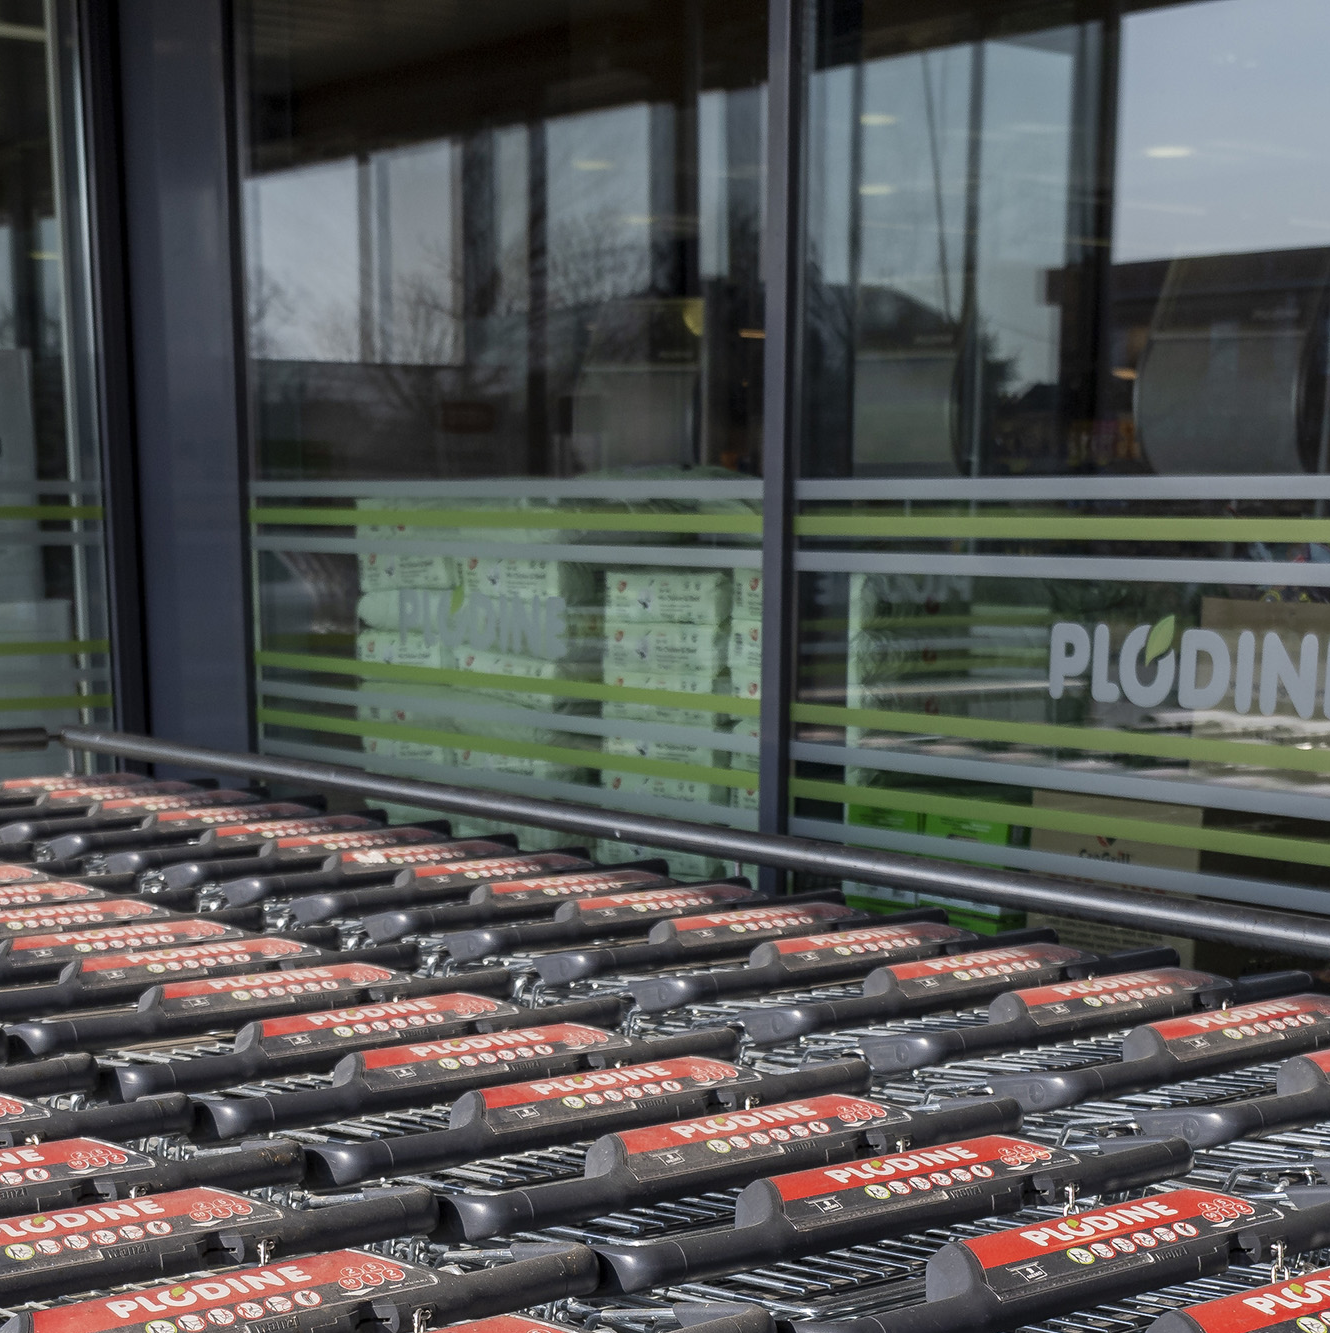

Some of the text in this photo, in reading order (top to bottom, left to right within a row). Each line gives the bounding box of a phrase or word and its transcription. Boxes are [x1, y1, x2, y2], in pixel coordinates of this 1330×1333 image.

[398, 588, 567, 661] PLODINE
[54, 922, 169, 944] PLODINE
[808, 925, 912, 947] PLODINE
[127, 943, 247, 965] PLODINE
[924, 947, 1030, 971] PLODINE
[209, 968, 333, 990] PLODINE
[1053, 972, 1161, 996] PLODINE
[307, 999, 437, 1026] PLODINE
[1189, 1002, 1299, 1028] PLODINE
[409, 1029, 546, 1057] PLODINE
[530, 1063, 672, 1095] PLODINE
[671, 1104, 820, 1140] PLODINE
[824, 1146, 978, 1184] PLODINE
[1020, 1201, 1178, 1247] PLODINE
[105, 1266, 311, 1318] PLODINE
